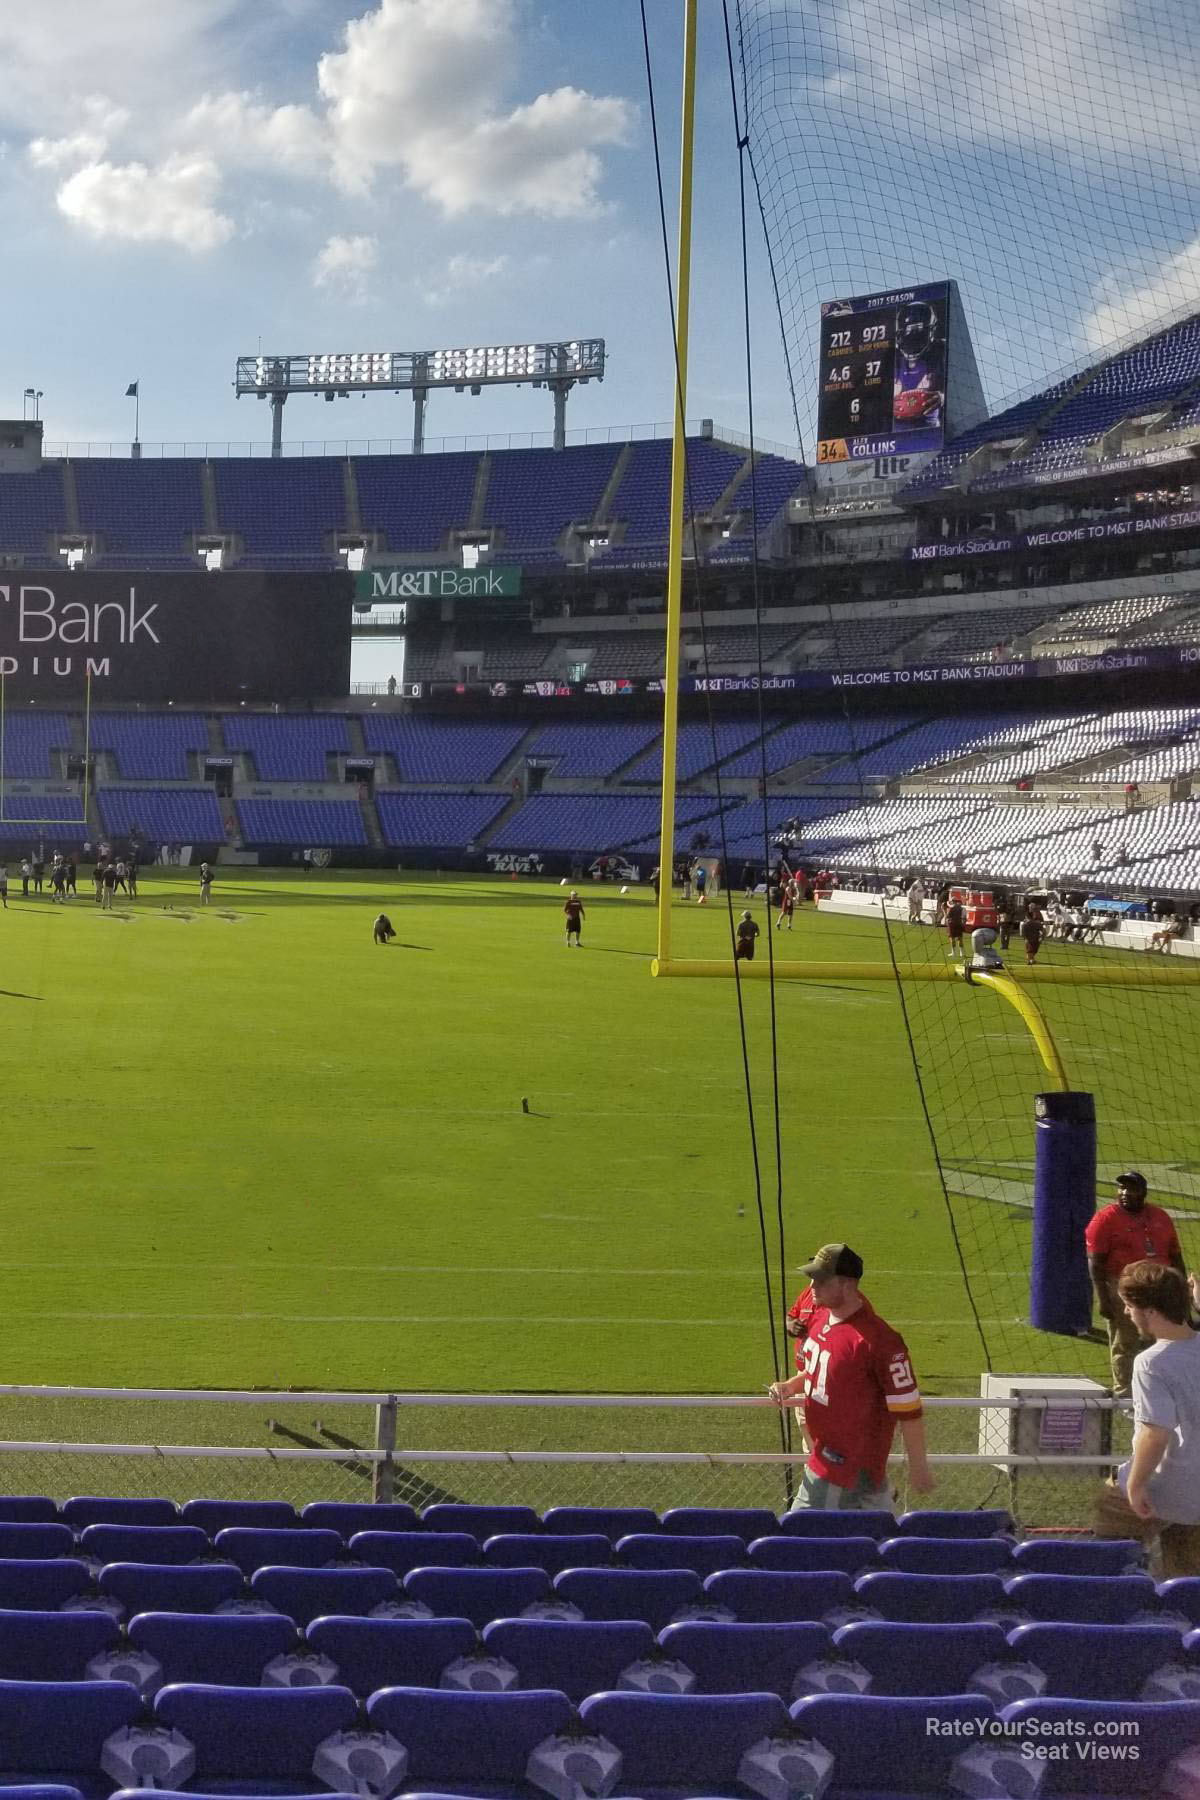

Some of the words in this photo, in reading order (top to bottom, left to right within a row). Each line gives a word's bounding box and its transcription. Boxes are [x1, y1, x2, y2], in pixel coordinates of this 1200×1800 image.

[886, 292, 915, 304] SEASON
[830, 331, 851, 348] 212
[862, 325, 886, 342] 973
[829, 366, 850, 382] 4.6
[865, 361, 881, 377] 37
[851, 398, 860, 414] 6
[821, 442, 837, 460] 34
[852, 440, 896, 457] COLLINS
[1027, 530, 1085, 547] WELCOME
[1087, 525, 1104, 538] TO
[1107, 521, 1134, 535] M&T
[1136, 516, 1168, 532] BANK
[911, 546, 938, 560] M&T
[939, 543, 965, 556] Bank
[966, 539, 1011, 555] Stadium
[371, 571, 438, 597] M&T
[440, 569, 503, 595] Bank
[18, 585, 160, 643] Bank
[1055, 659, 1081, 674] M&T
[1081, 657, 1105, 672] Bank
[1106, 654, 1148, 669] Stadium
[724, 678, 750, 690] Bank
[751, 676, 795, 690] Sadium
[832, 672, 891, 686] WELCOME
[893, 670, 910, 683] TO
[913, 669, 939, 682] M&T
[941, 668, 972, 681] BANK
[973, 664, 1025, 679] STADIUM
[411, 685, 419, 696] 0
[803, 1336, 831, 1407] 21
[889, 1359, 915, 1389] 21
